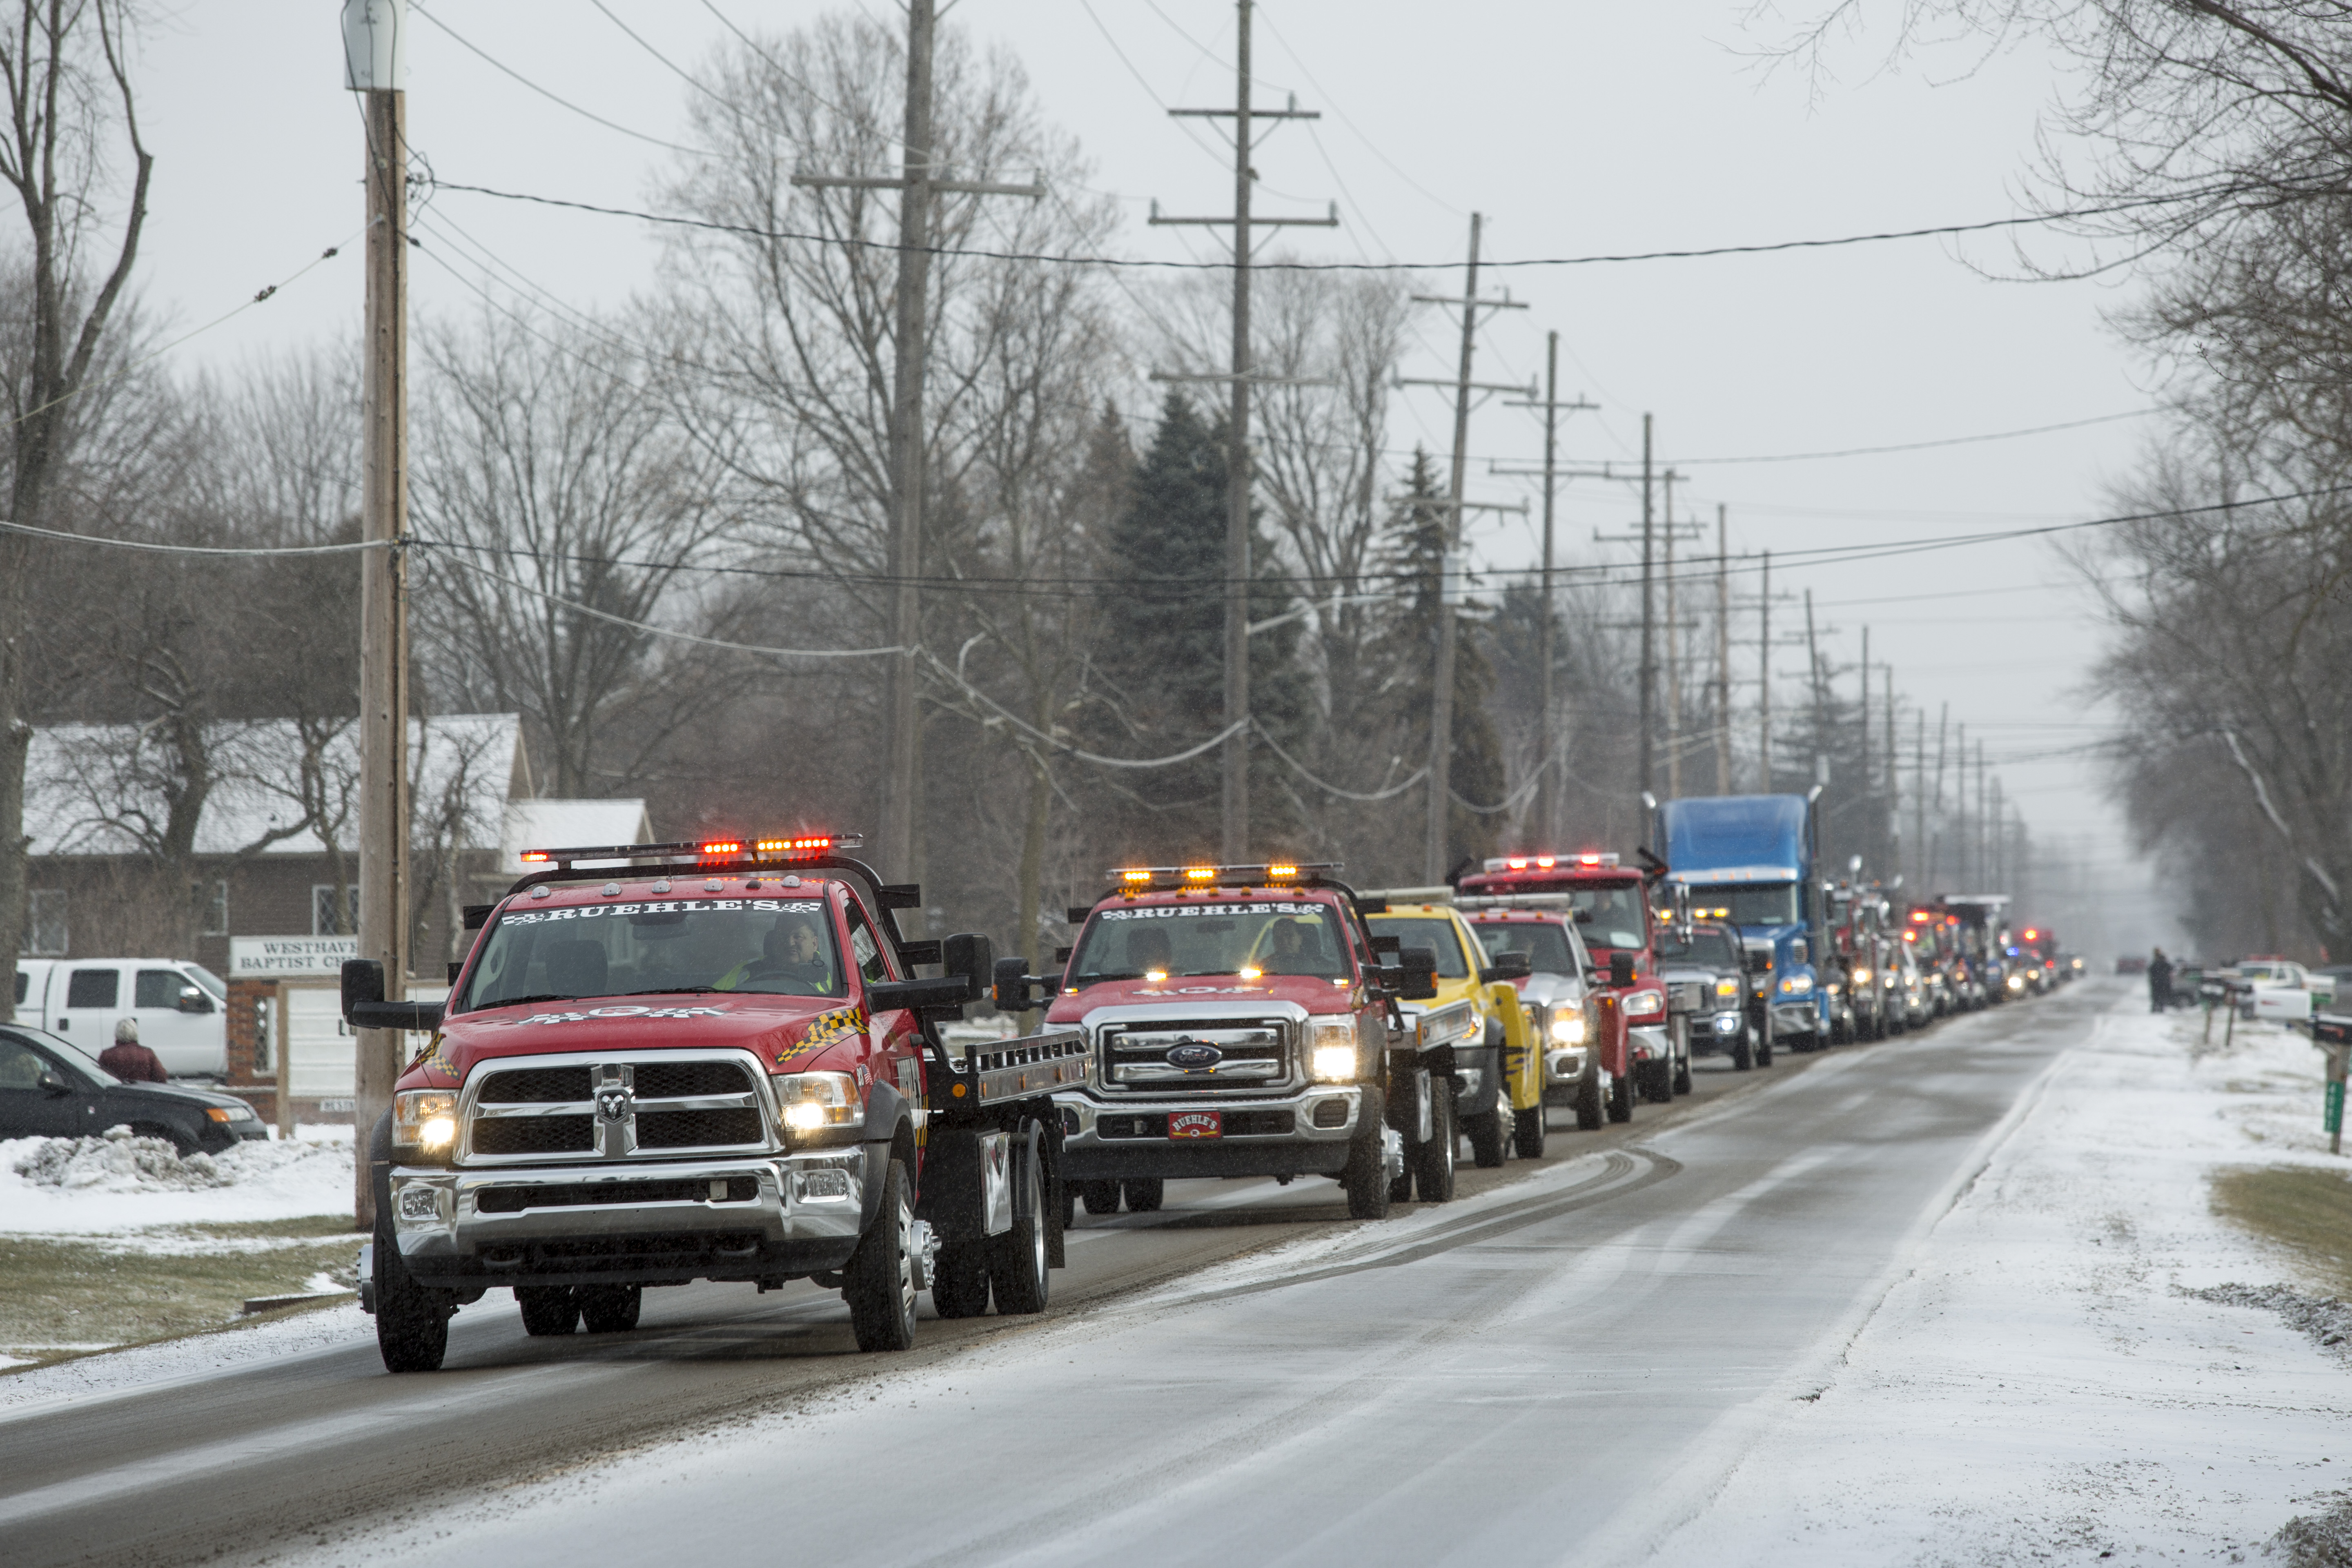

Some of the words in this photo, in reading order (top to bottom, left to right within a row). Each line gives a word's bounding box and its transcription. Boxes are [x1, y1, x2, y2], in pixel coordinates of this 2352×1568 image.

[544, 900, 780, 922] RUEHLE'S
[1133, 903, 1295, 919] RUEHLE'S
[264, 941, 358, 955] WESTHAVE
[241, 957, 314, 969] BAPTIST
[856, 1067, 864, 1087] 23
[1172, 1114, 1217, 1131] RUEHLE'S
